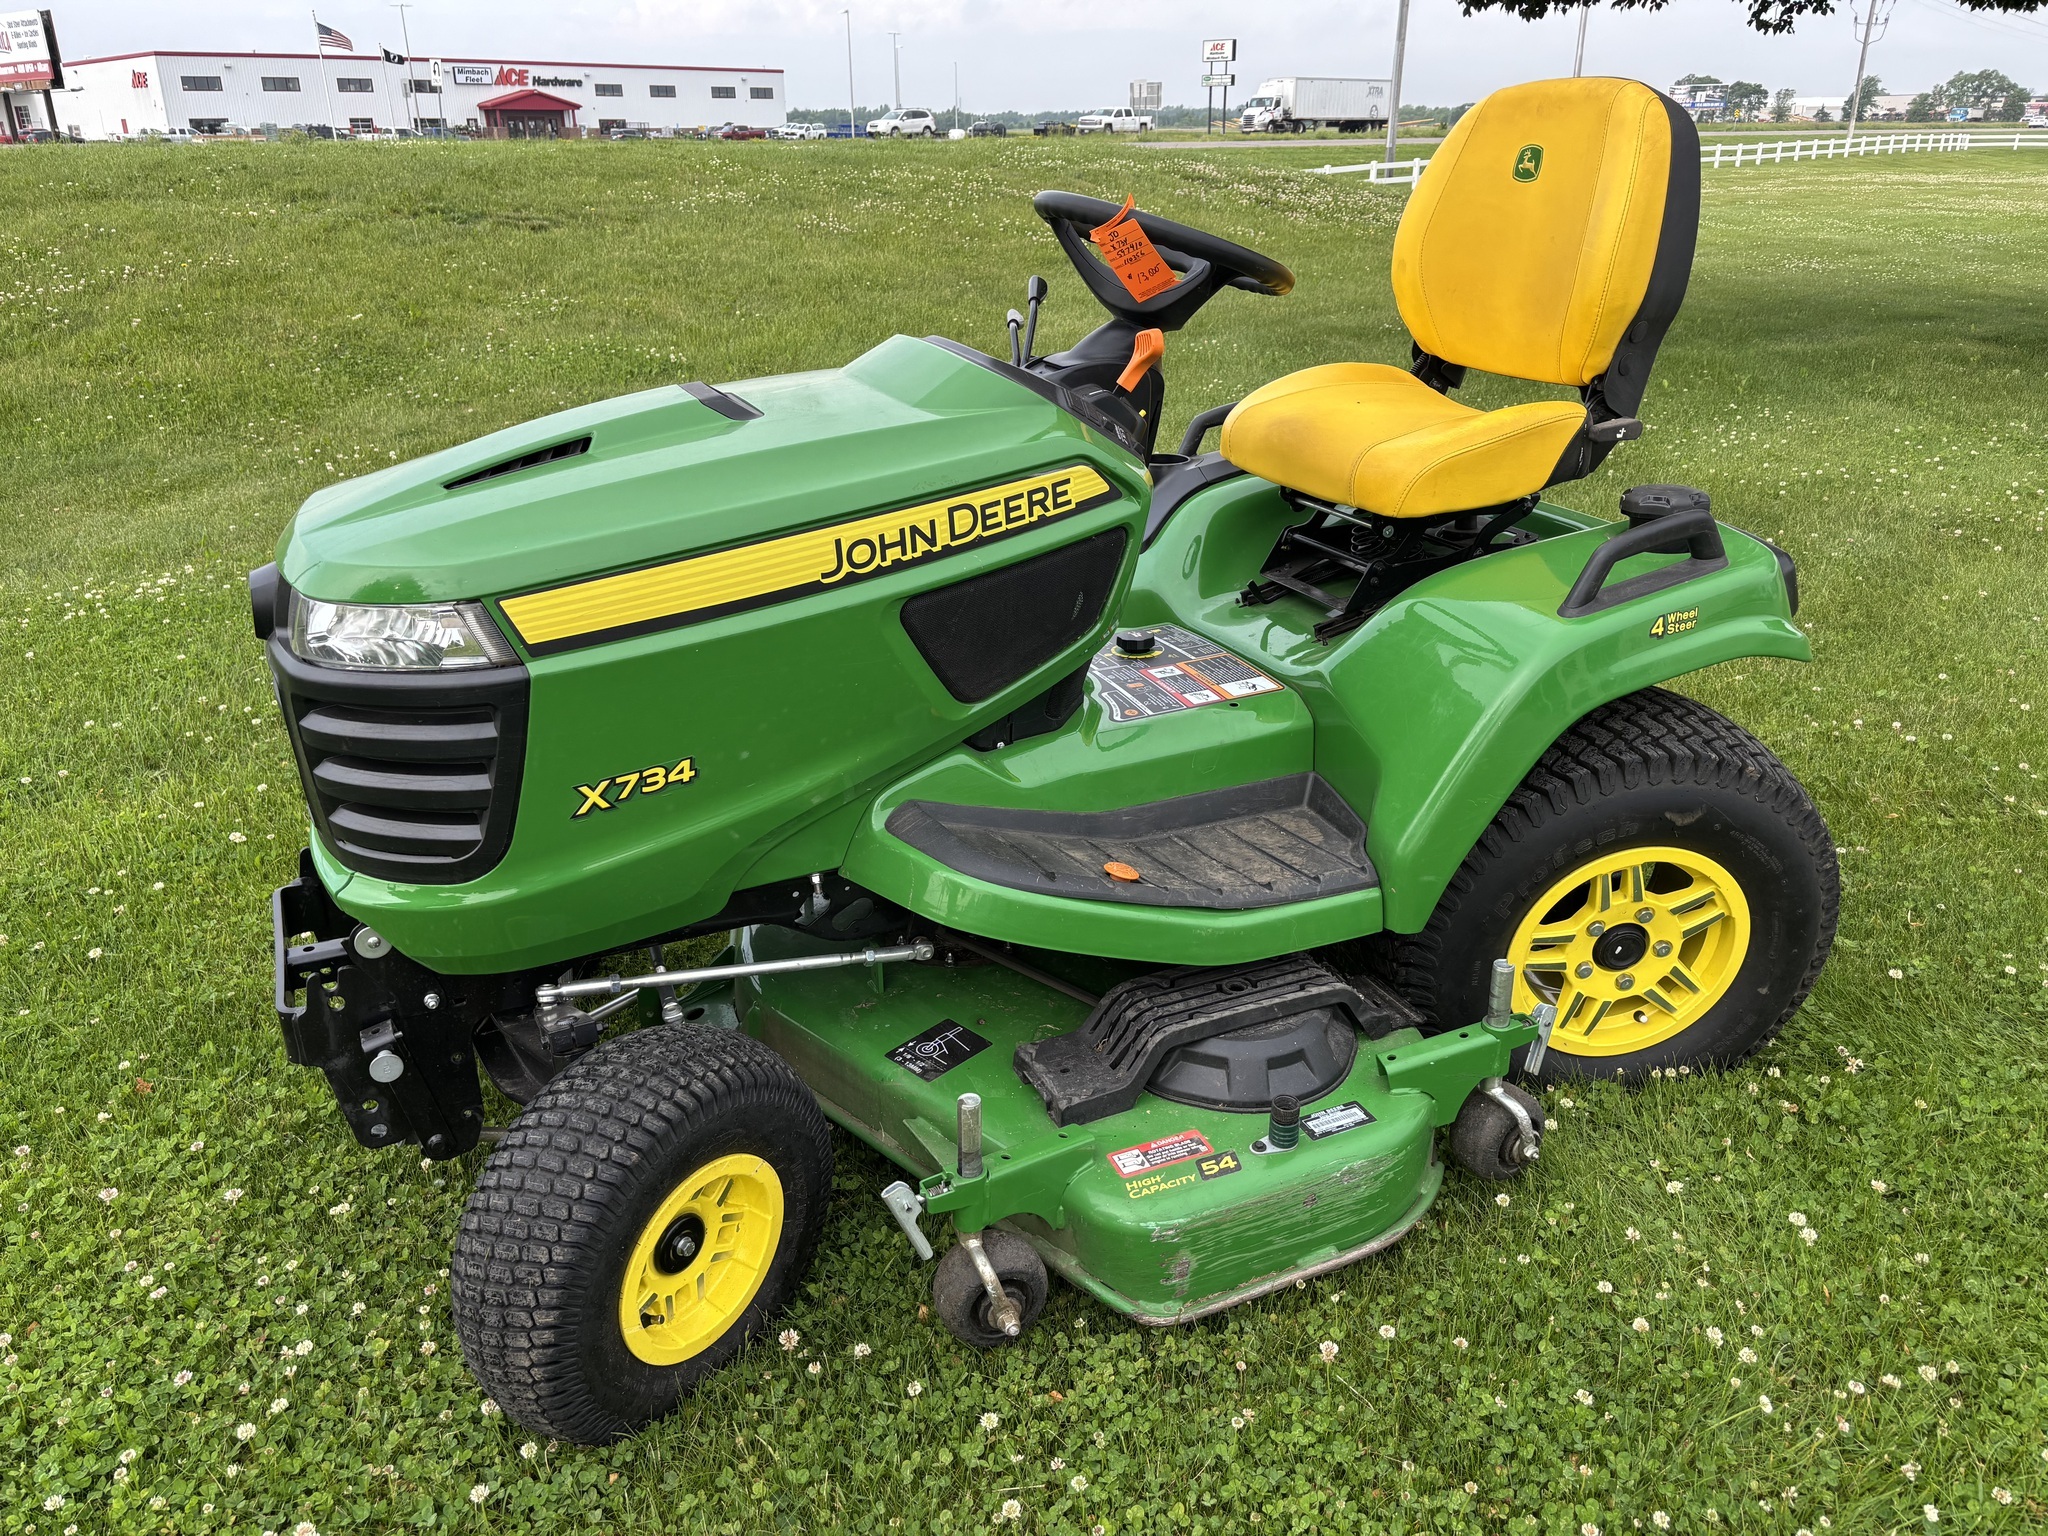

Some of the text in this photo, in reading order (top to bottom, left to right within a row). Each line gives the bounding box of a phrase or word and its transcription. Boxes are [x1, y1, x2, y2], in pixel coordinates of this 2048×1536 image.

[1210, 43, 1225, 51] ACE
[132, 69, 148, 88] ACE
[494, 65, 583, 87] ACE Hardware
[820, 478, 1073, 581] JOHN DEERE
[1650, 606, 1698, 638] 4 Wheel
[1666, 619, 1697, 635] Steer
[573, 758, 696, 817] X734
[1156, 1135, 1184, 1145] DANGER
[1201, 1155, 1237, 1175] 54
[1125, 1175, 1161, 1192] HIGH
[1129, 1173, 1196, 1199] CAPACITY
